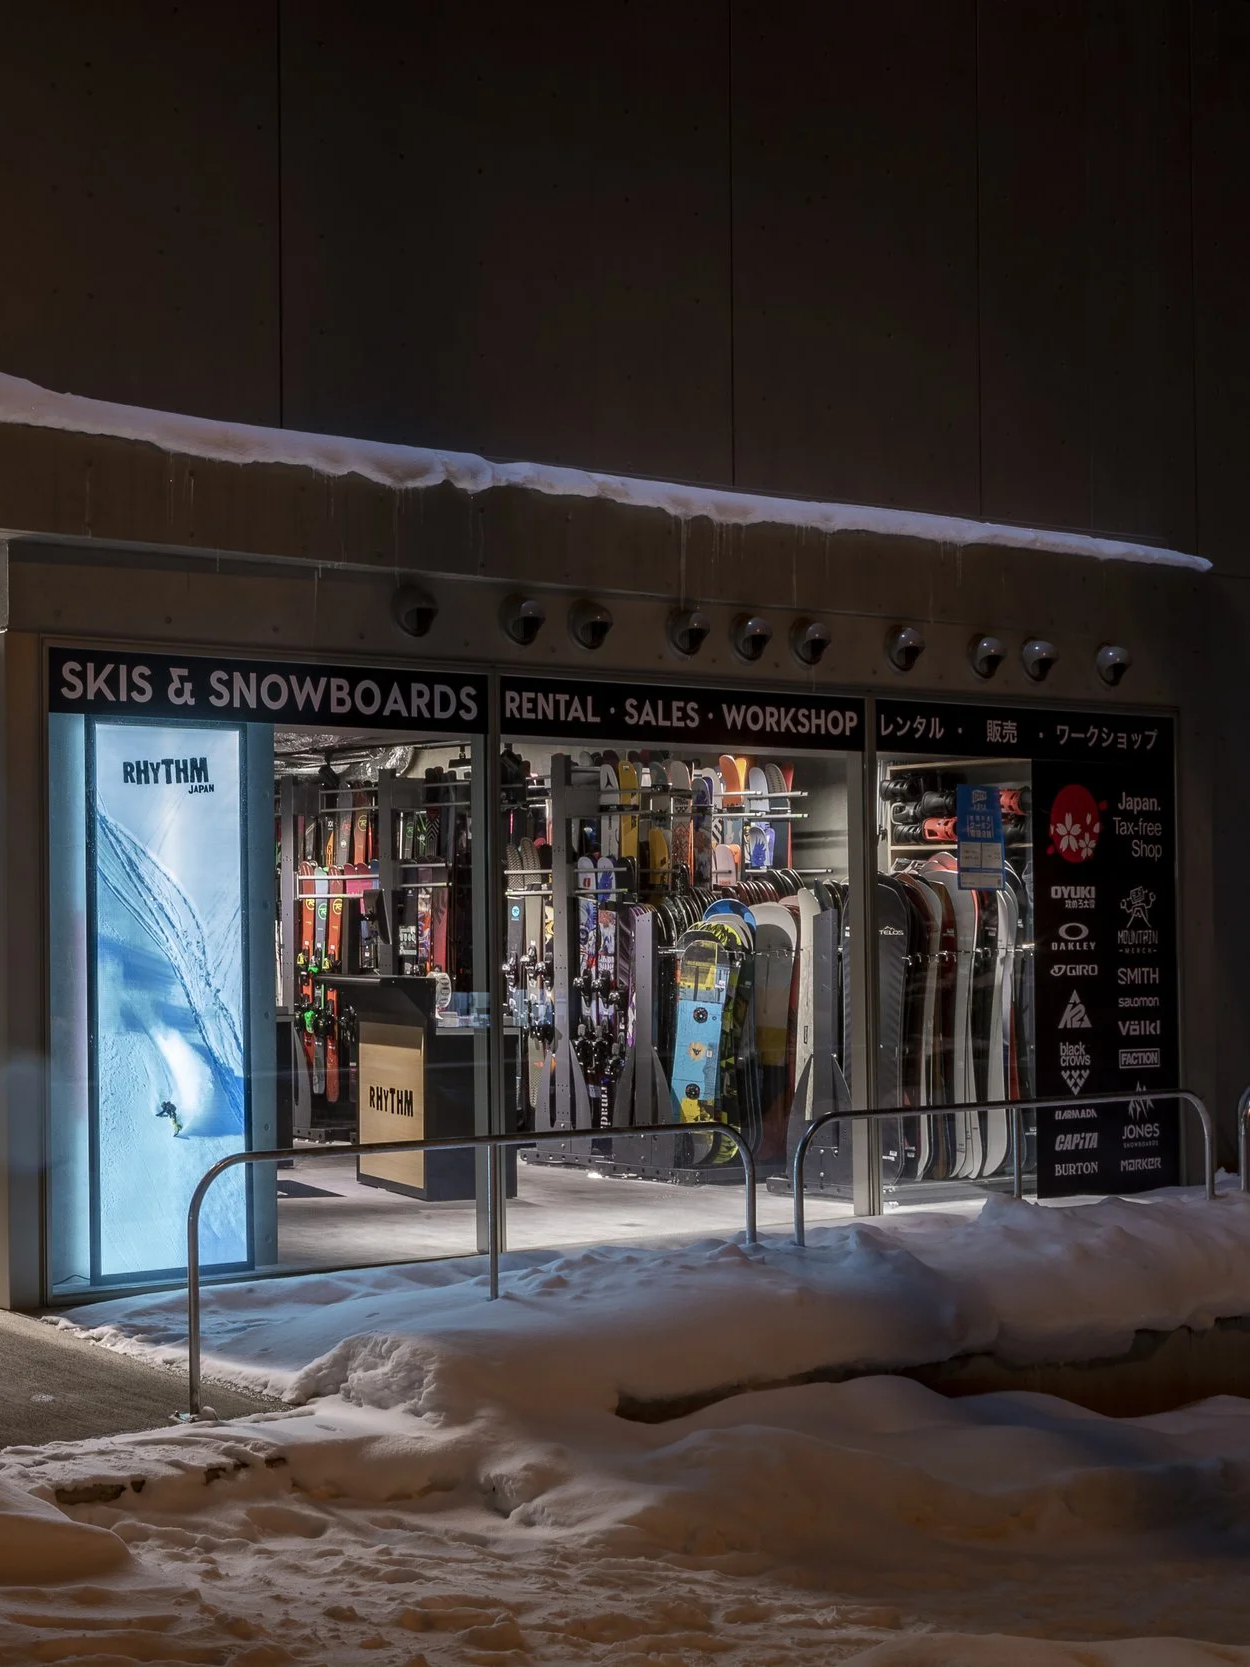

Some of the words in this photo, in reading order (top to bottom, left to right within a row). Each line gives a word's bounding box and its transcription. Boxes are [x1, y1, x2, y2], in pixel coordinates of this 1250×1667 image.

[60, 660, 153, 704] SKIS
[167, 667, 196, 706] &
[208, 670, 479, 721] SNOWBOARDS
[505, 690, 600, 723] RENTAL
[624, 698, 700, 728] SALES
[721, 703, 858, 736] WORKSHOP
[880, 714, 945, 740] レンタル
[986, 719, 1018, 744] 販売
[1056, 724, 1159, 750] ワークショップ
[122, 756, 210, 785] RHYTHM
[188, 784, 215, 794] JAPAN
[1112, 816, 1162, 837] Tax-free
[1131, 839, 1162, 861] Shop
[1050, 886, 1096, 899] OYUKI
[1051, 942, 1096, 951] OAKLEY
[1066, 964, 1098, 976] GIRO
[1117, 967, 1159, 985] SMITH
[1118, 996, 1160, 1008] salomon
[1118, 1019, 1161, 1036] Völkl
[1060, 1041, 1086, 1056] black
[1060, 1054, 1091, 1067] crows
[1121, 1051, 1158, 1066] FACTION
[369, 1085, 414, 1118] RHYTHM
[1054, 1161, 1099, 1177] BURTON
